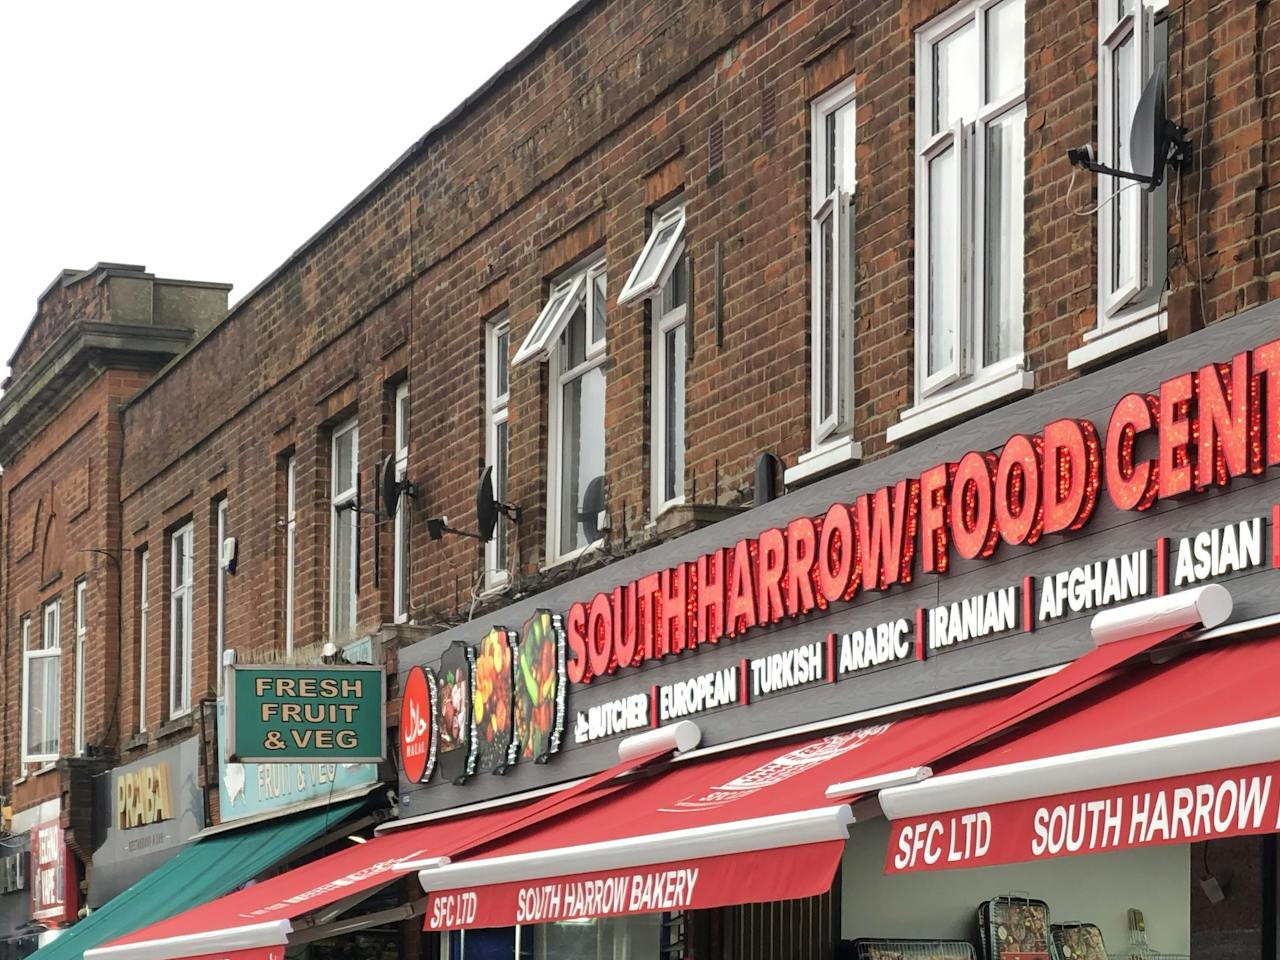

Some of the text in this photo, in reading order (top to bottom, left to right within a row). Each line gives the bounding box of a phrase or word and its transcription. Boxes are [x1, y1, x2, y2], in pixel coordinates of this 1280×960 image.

[567, 561, 699, 685] SOUTH
[699, 477, 919, 644] HARROW
[920, 418, 1099, 574] FOOD
[588, 693, 648, 740] BUTCHER
[660, 666, 738, 720] EUROPEAN
[751, 641, 825, 696] TURKISH
[839, 618, 913, 674] ARABIC
[928, 586, 1020, 650] IRANIAN
[1038, 549, 1152, 621] AFGHANI
[1174, 517, 1267, 586] ASIAN
[255, 677, 363, 698] FRESH
[261, 703, 359, 723] FRUIT
[263, 729, 359, 750] & VEG
[406, 743, 425, 758] HALAL
[258, 763, 292, 802] FRUIT
[310, 763, 336, 788] VEG
[1031, 797, 1124, 857] SOUTH
[1127, 775, 1271, 844] HARROW
[895, 811, 992, 870] SFC LTD
[430, 892, 477, 929] SFC LTD
[516, 868, 700, 922] SOUTH HARROW BAKERY
